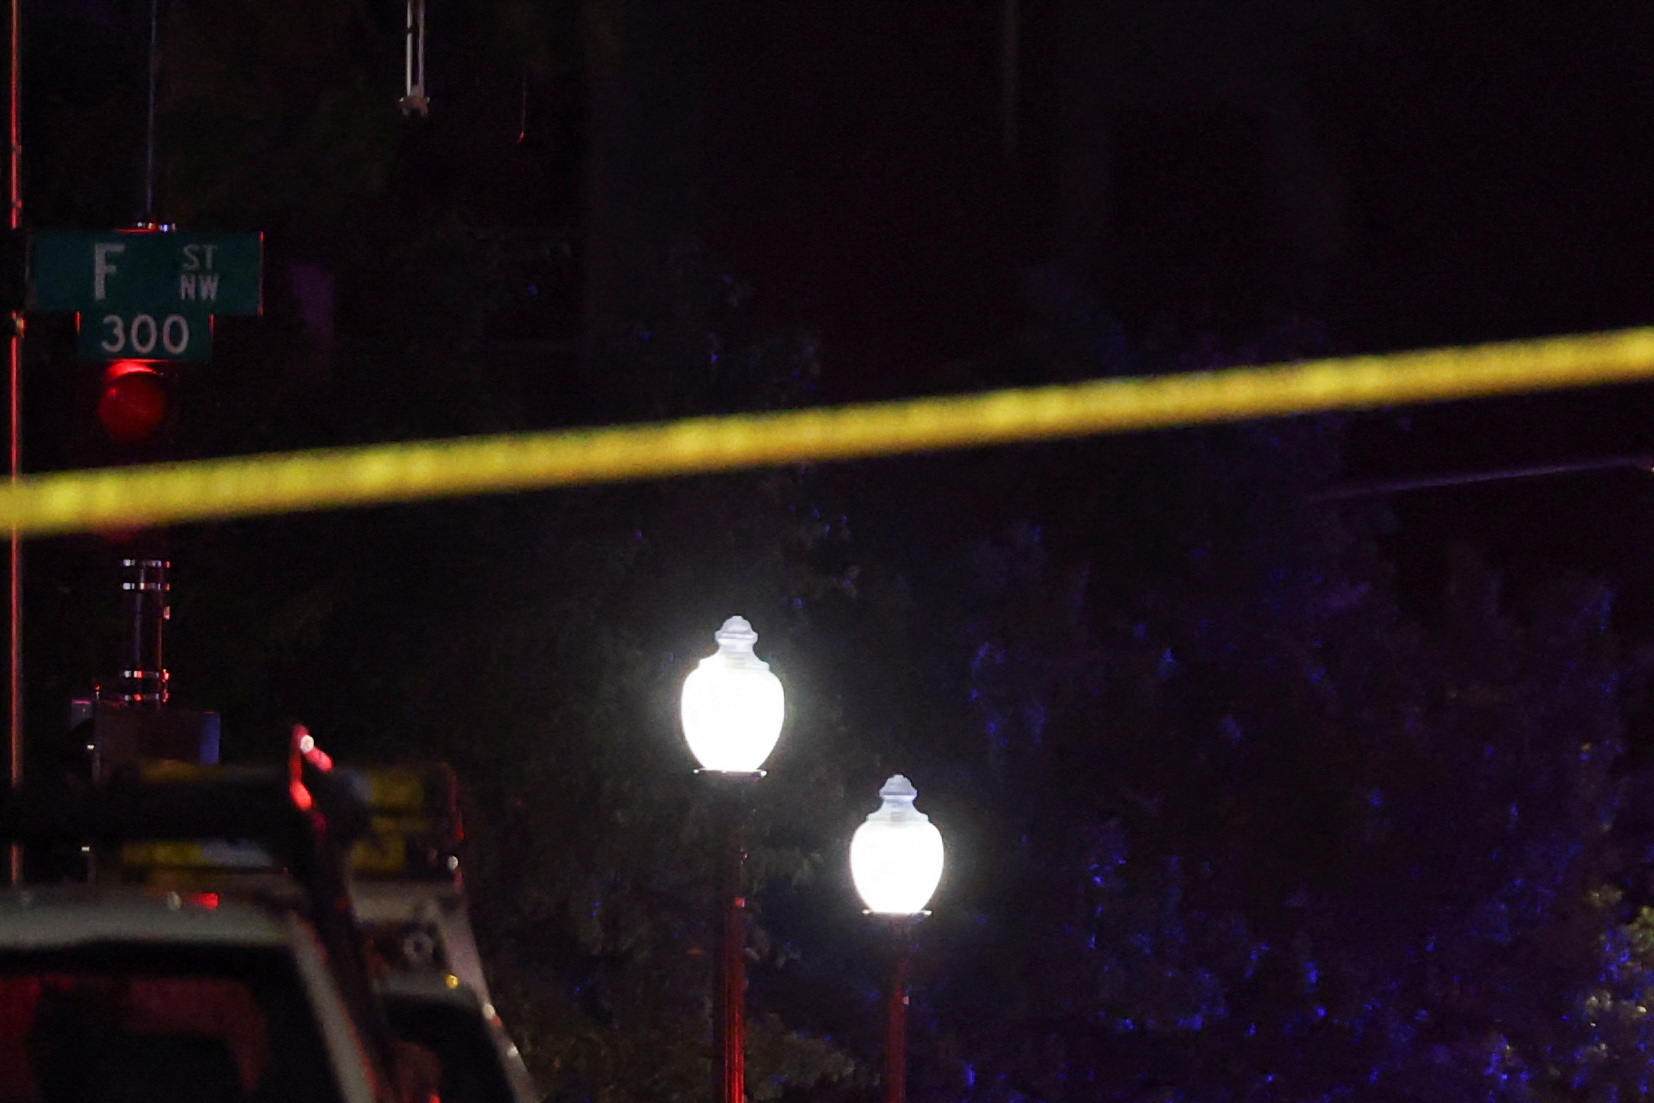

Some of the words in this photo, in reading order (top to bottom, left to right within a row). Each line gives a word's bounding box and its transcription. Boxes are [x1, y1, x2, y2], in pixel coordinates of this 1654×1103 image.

[94, 243, 126, 300] F
[182, 245, 218, 270] ST
[180, 273, 219, 300] NW
[102, 314, 190, 354] 300
